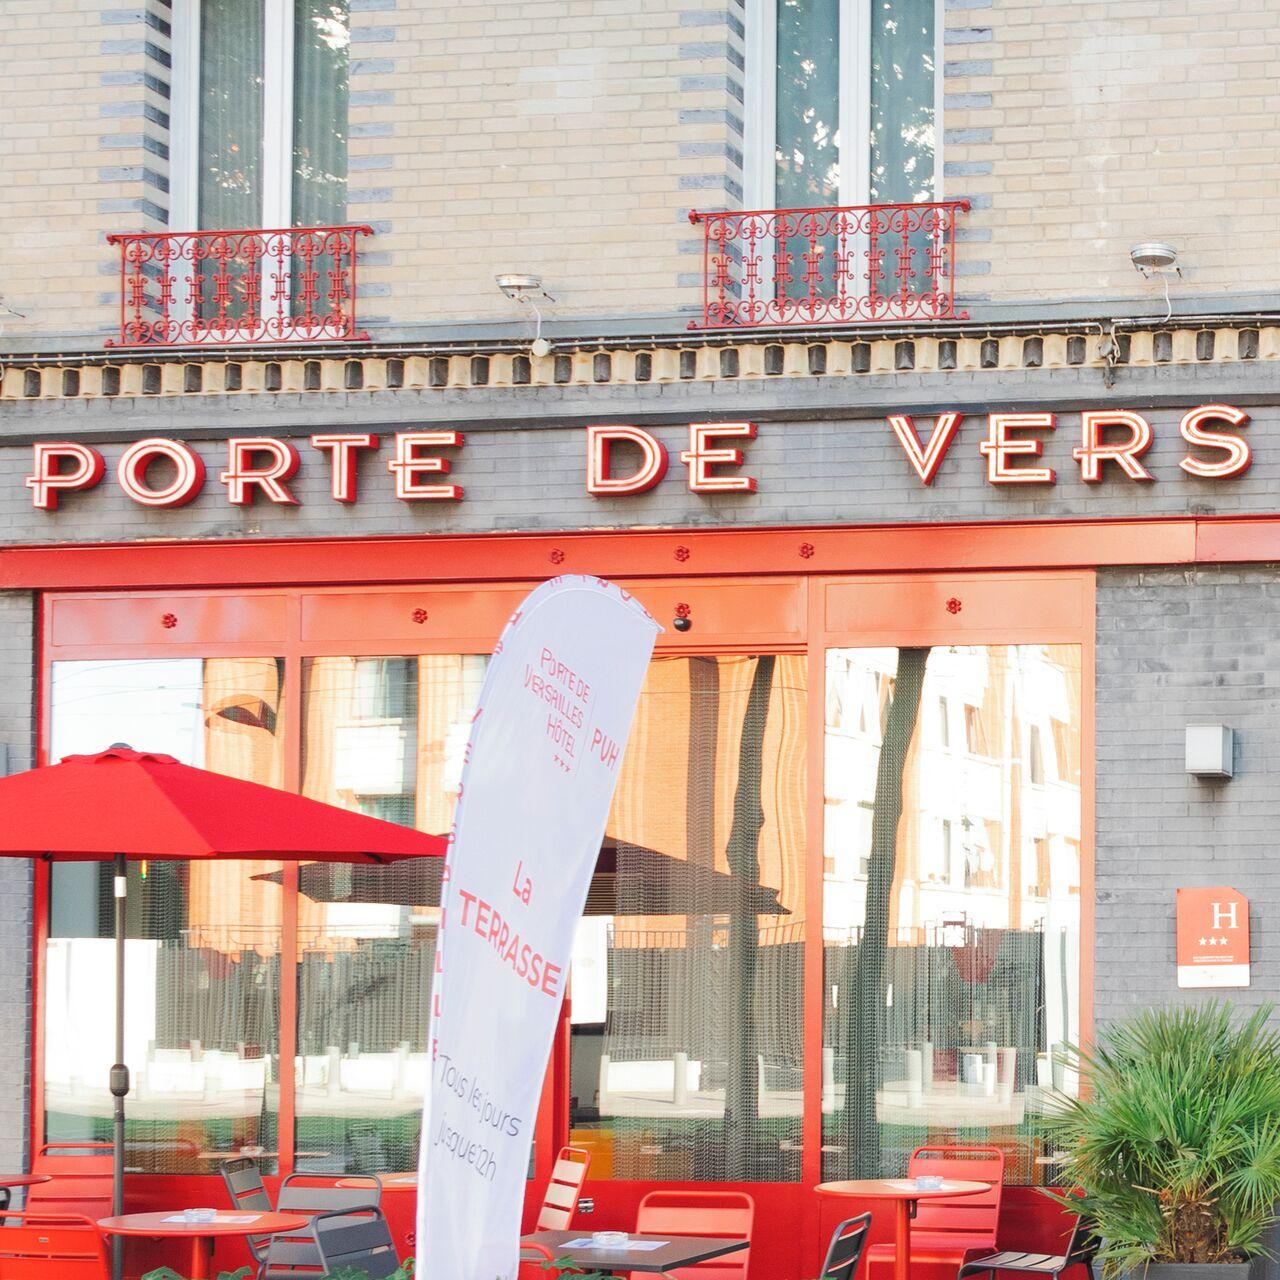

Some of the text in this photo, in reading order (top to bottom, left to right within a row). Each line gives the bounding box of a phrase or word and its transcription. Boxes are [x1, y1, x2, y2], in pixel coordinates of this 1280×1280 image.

[26, 430, 466, 511] PORTE
[586, 421, 758, 498] DE
[524, 663, 584, 729] VERSAILLES
[541, 647, 590, 704] PORTE DE
[512, 860, 532, 906] La
[459, 889, 561, 998] TERRASSE
[1211, 902, 1239, 929] H
[479, 1091, 522, 1137] jours
